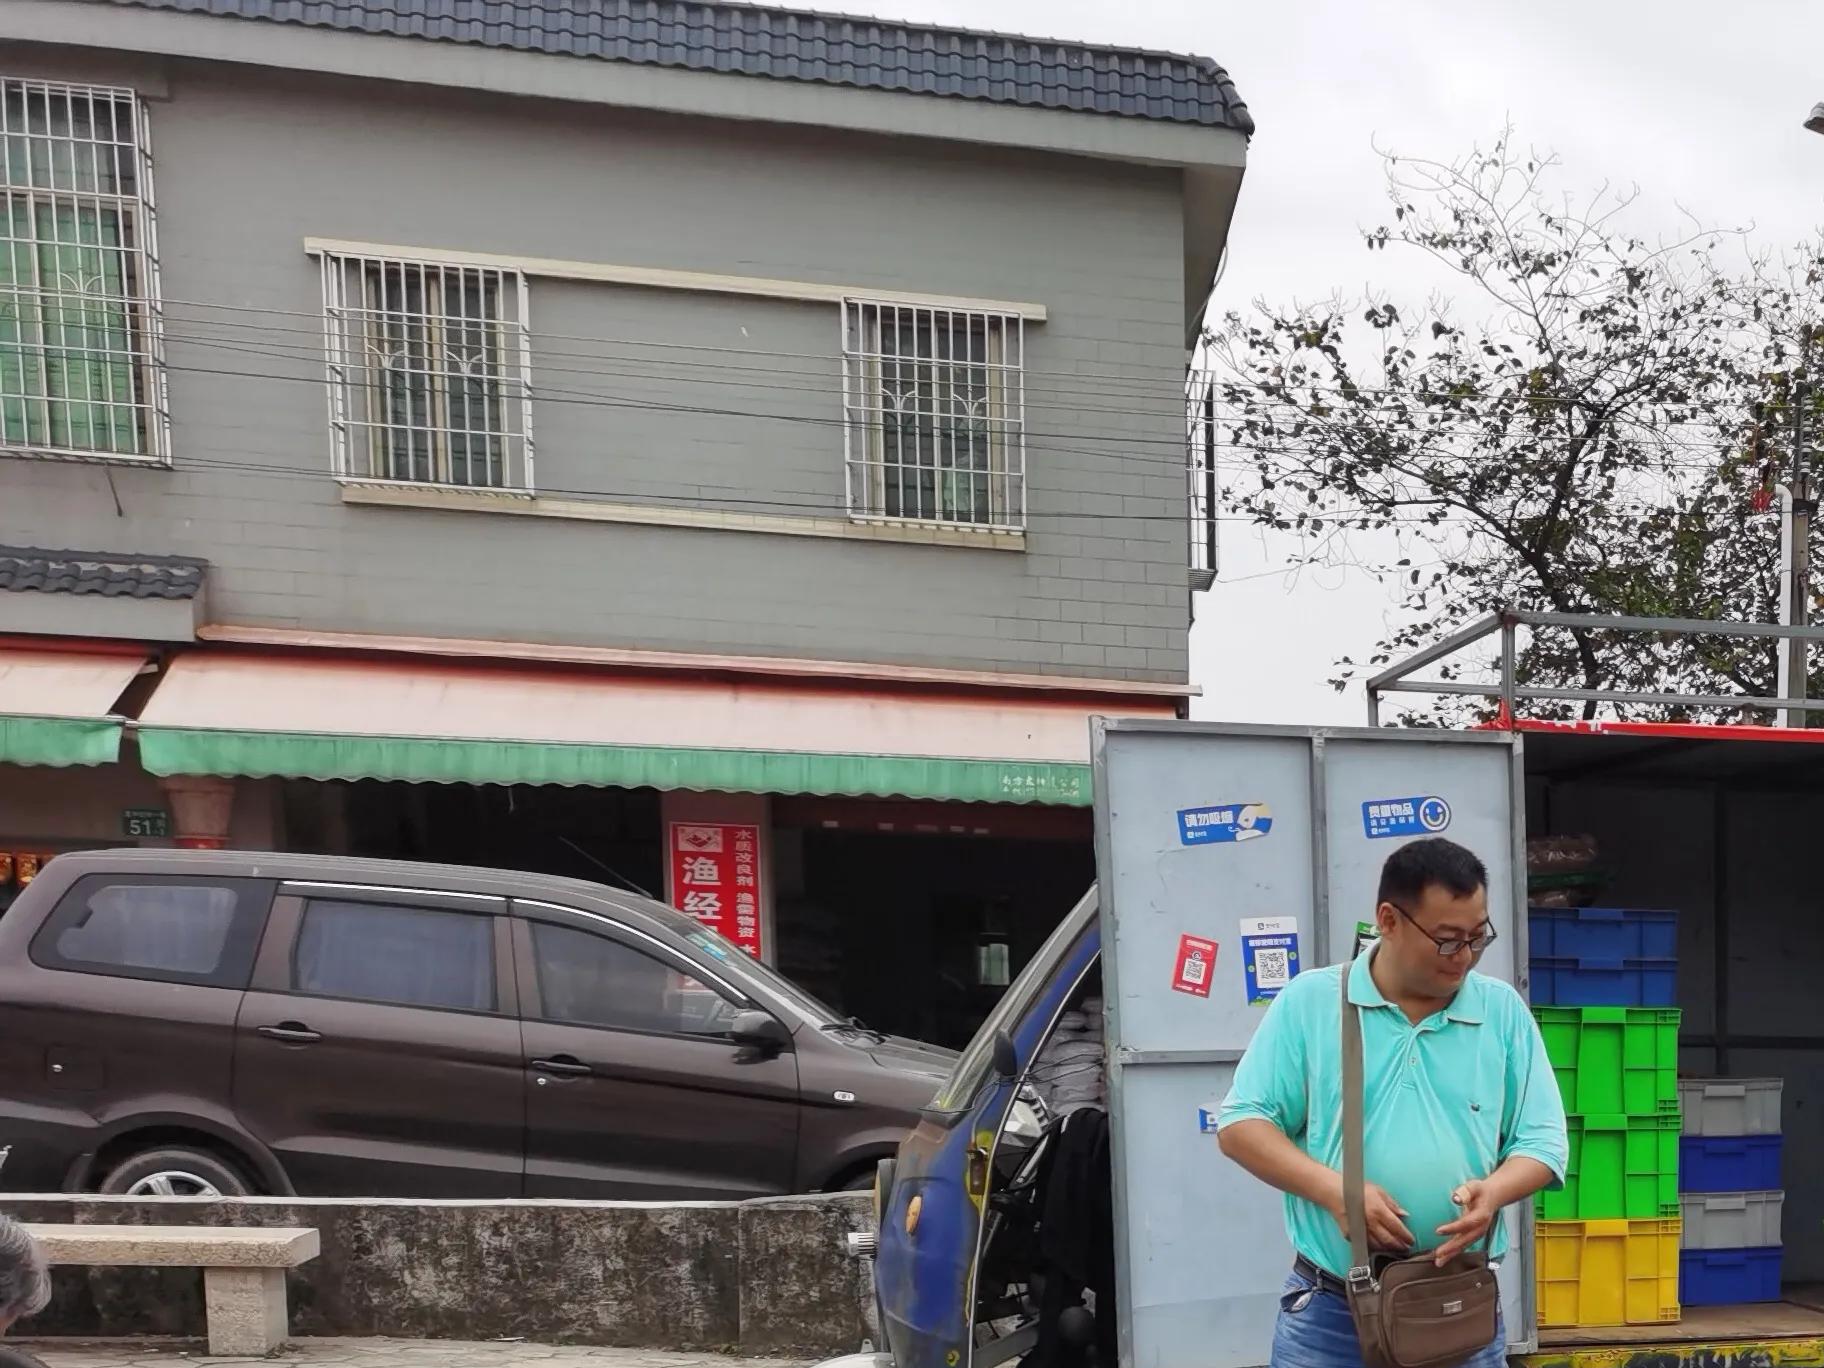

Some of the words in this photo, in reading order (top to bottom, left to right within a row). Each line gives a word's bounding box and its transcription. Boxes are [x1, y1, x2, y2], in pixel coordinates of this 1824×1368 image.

[130, 819, 151, 835] 51
[735, 829, 754, 887] 水质改良剂
[682, 857, 723, 932] 渔经
